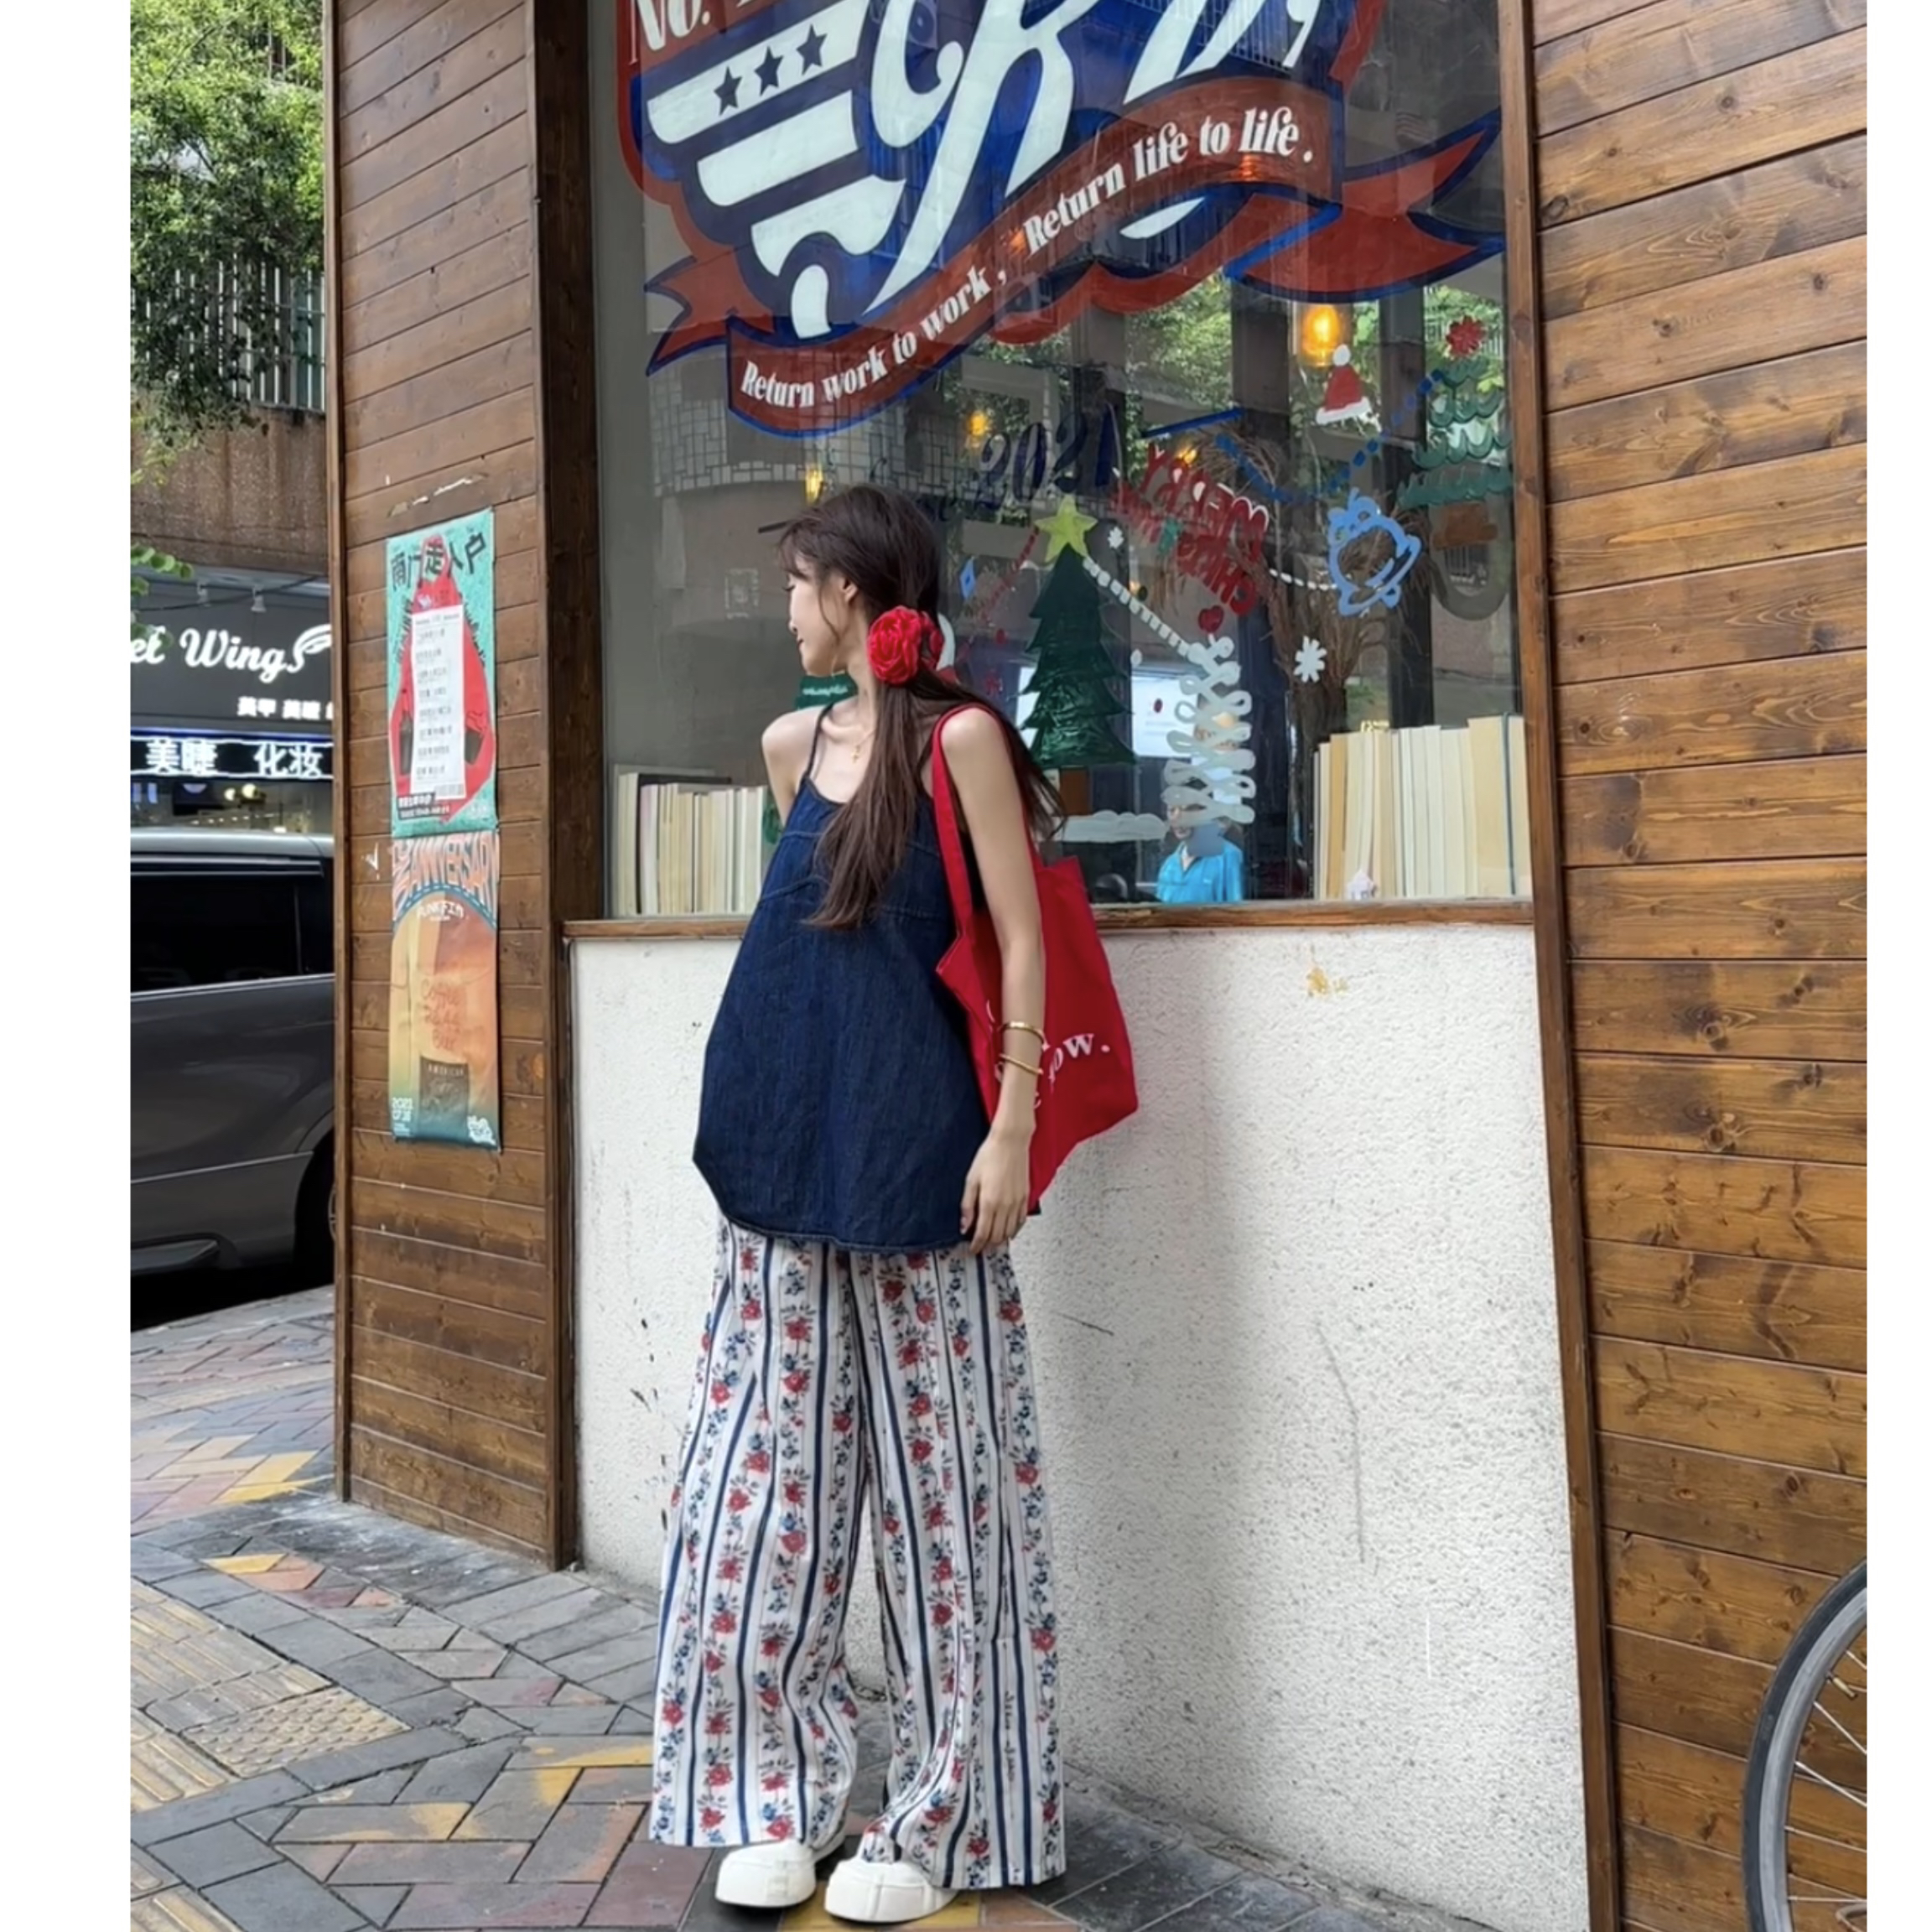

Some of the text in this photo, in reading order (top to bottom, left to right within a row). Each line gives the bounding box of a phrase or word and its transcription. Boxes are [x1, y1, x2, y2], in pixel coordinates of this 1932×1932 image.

[740, 361, 815, 408] Return
[822, 349, 889, 401] work
[892, 330, 917, 366] to
[1022, 162, 1126, 256] Return
[1132, 121, 1189, 182] life
[1200, 116, 1231, 154] to
[975, 402, 1119, 511] 2021
[179, 624, 330, 683] Wings
[253, 743, 323, 777] 化妆
